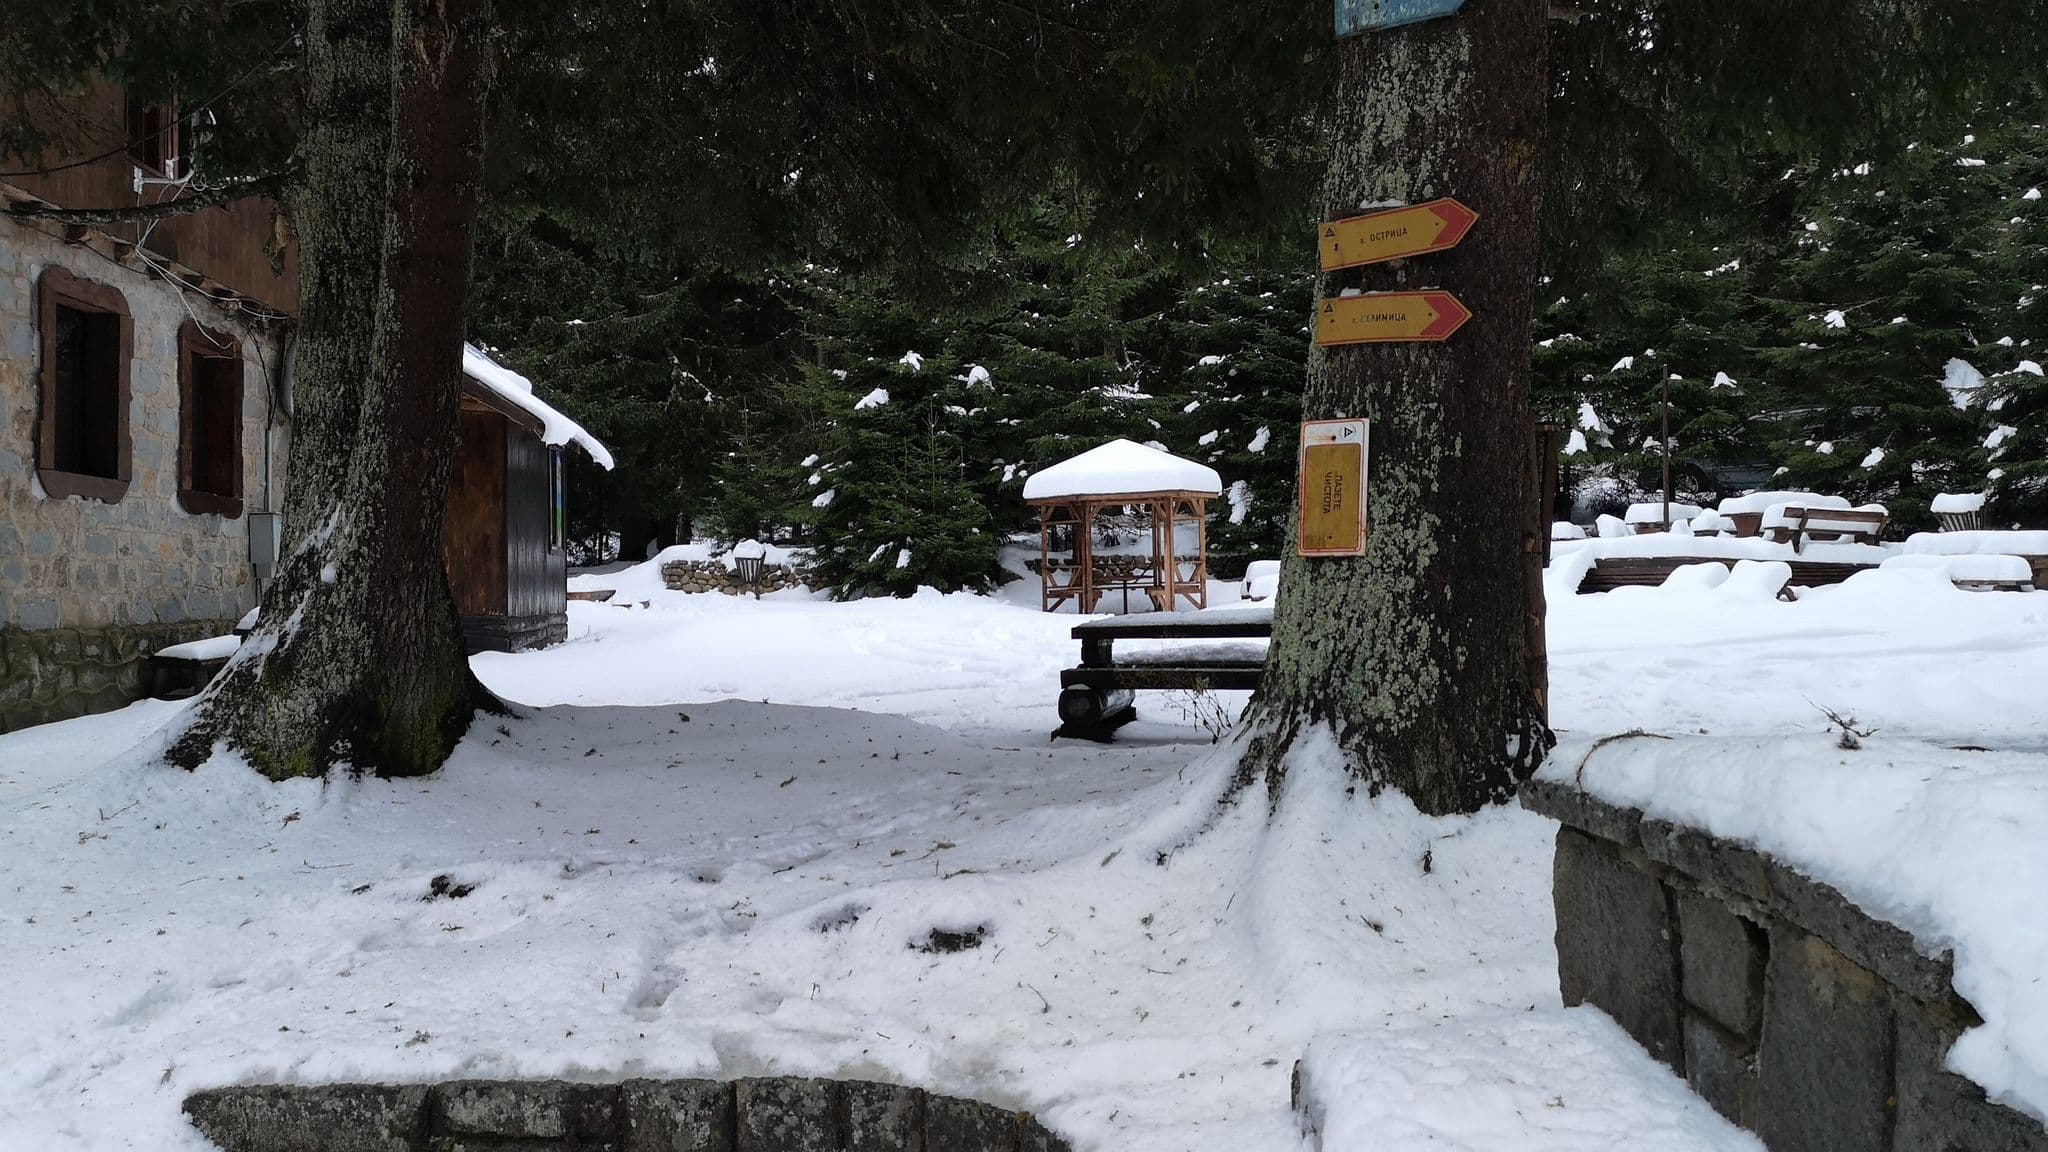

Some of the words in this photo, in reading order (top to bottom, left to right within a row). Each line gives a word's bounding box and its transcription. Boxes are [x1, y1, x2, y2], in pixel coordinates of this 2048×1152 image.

[1370, 227, 1408, 242] ОСТРИЦА
[1323, 472, 1332, 514] ЧИСТОТА
[1333, 475, 1342, 510] ПАЗЕТЕ
